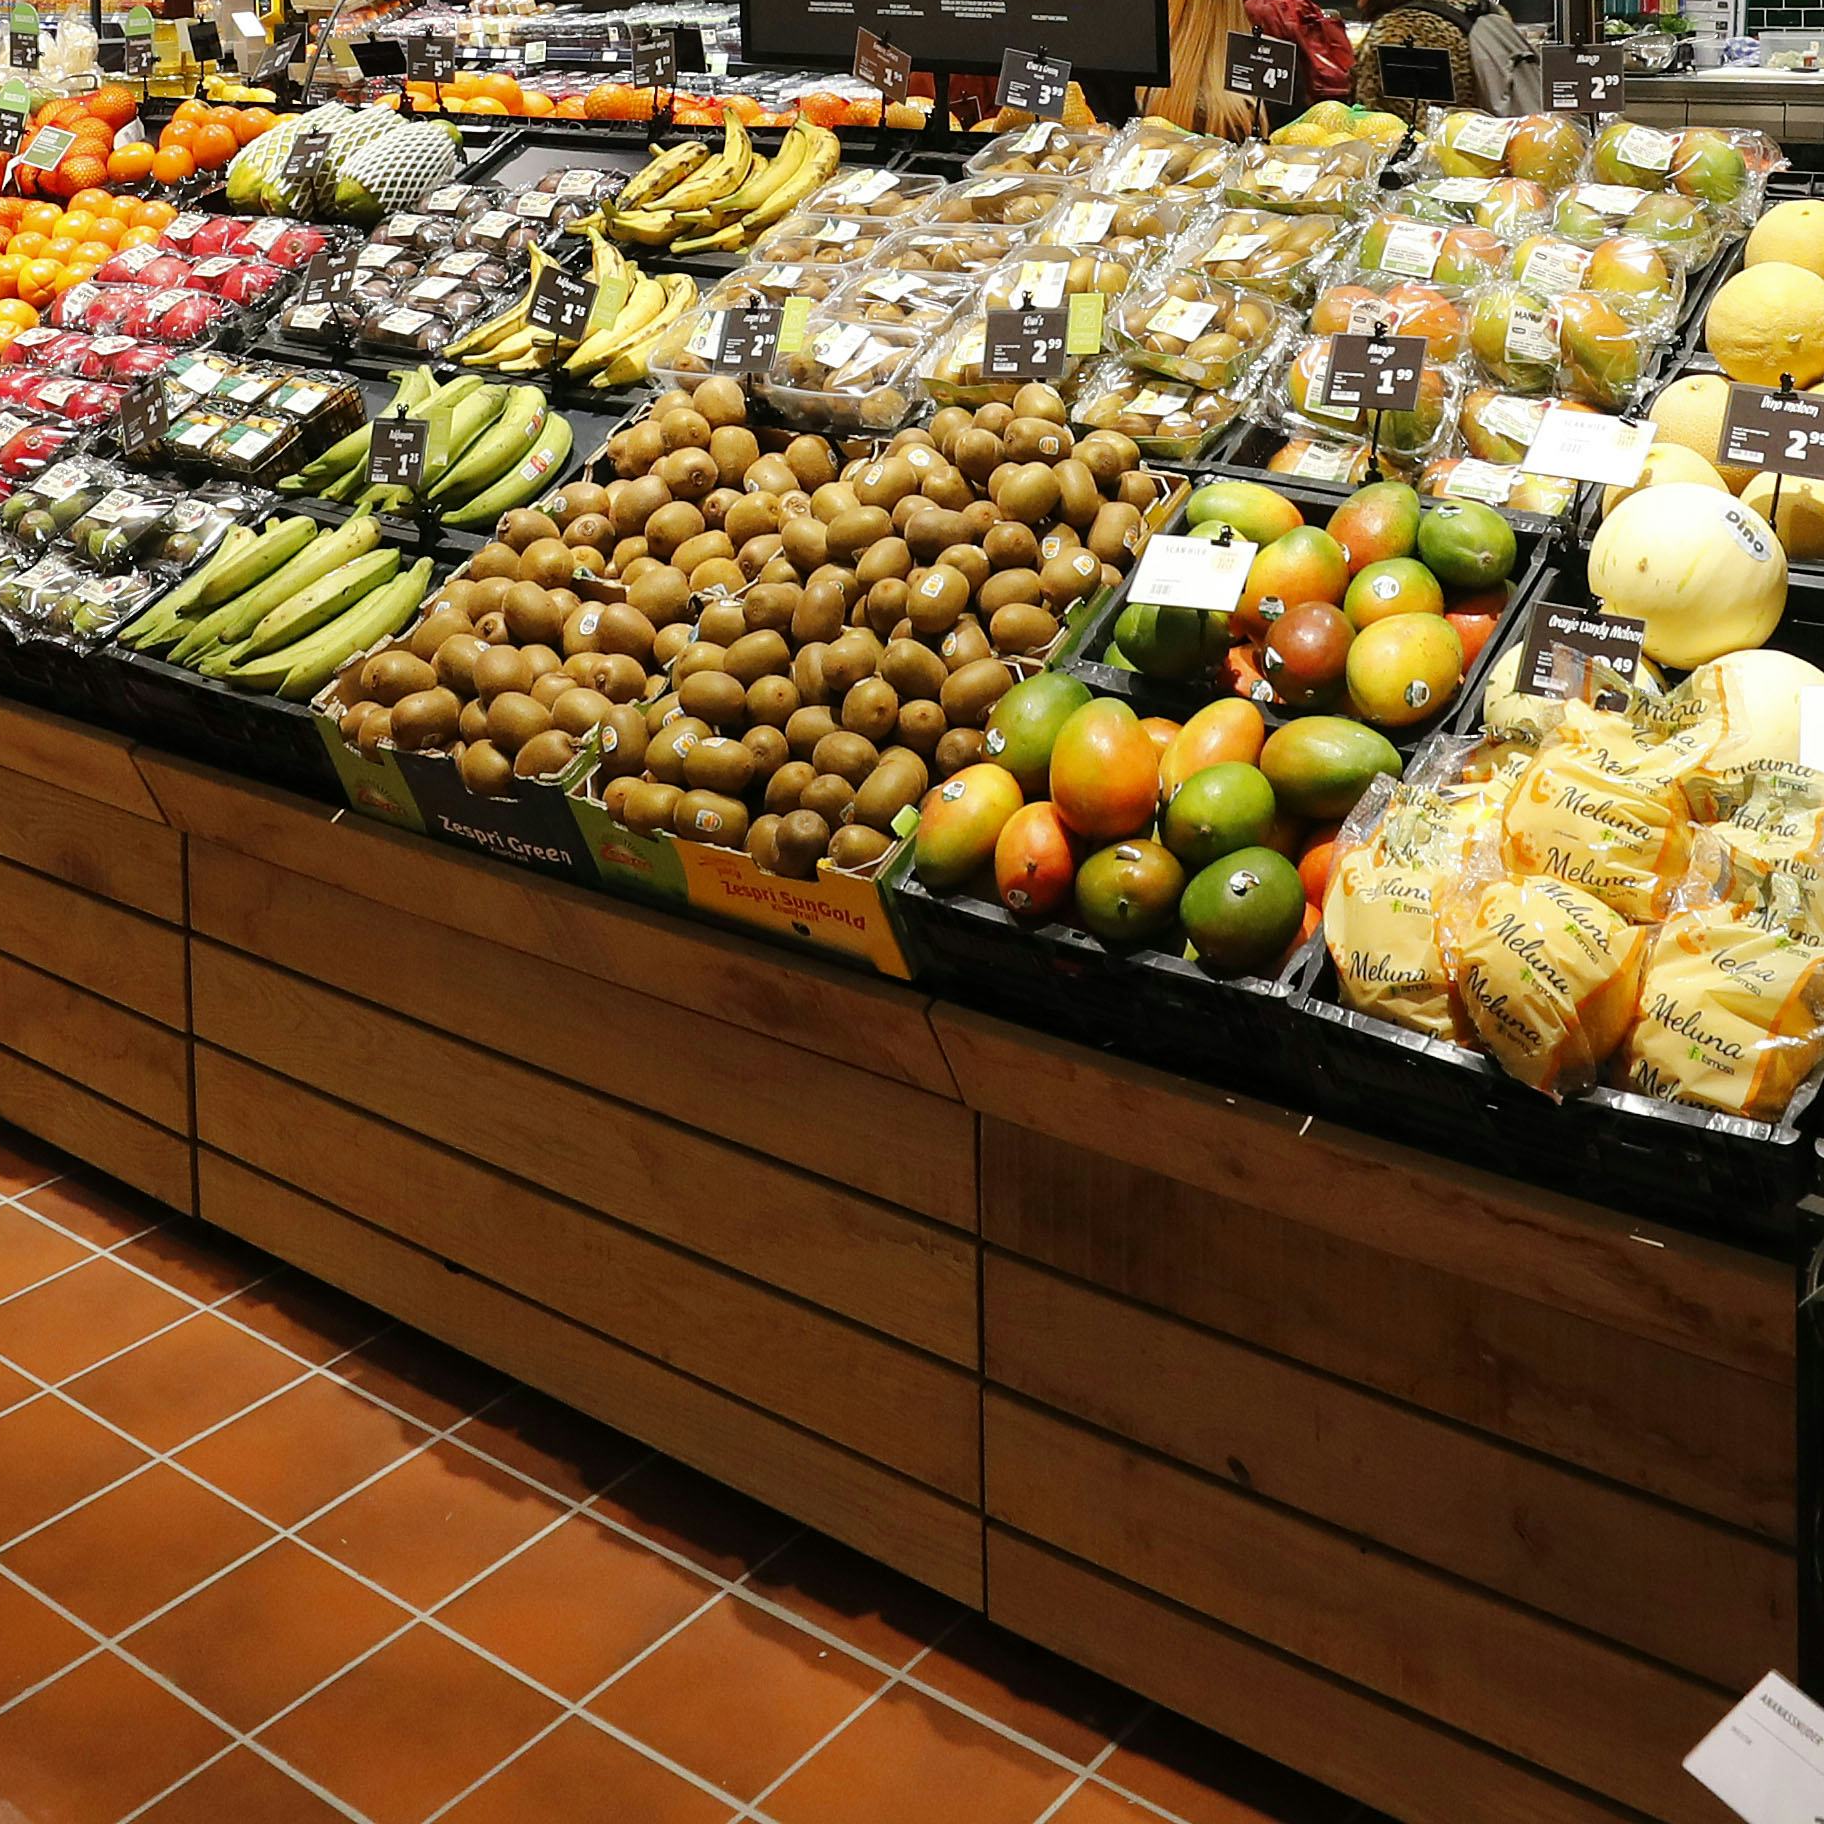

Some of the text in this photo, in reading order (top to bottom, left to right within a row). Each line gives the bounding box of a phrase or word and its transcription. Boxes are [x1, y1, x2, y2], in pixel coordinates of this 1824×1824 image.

[1725, 510, 1765, 554] Dino
[437, 813, 573, 866] Zespri Green
[1554, 786, 1653, 841] Meluna
[1542, 847, 1639, 888] Meluna
[721, 880, 866, 931] Zespri SunGold
[1533, 881, 1613, 956] Meluna
[1349, 950, 1432, 984] Meluna
[1488, 913, 1571, 995] Meluna
[1467, 965, 1543, 1046] Meluna
[1648, 993, 1745, 1060] Meluna
